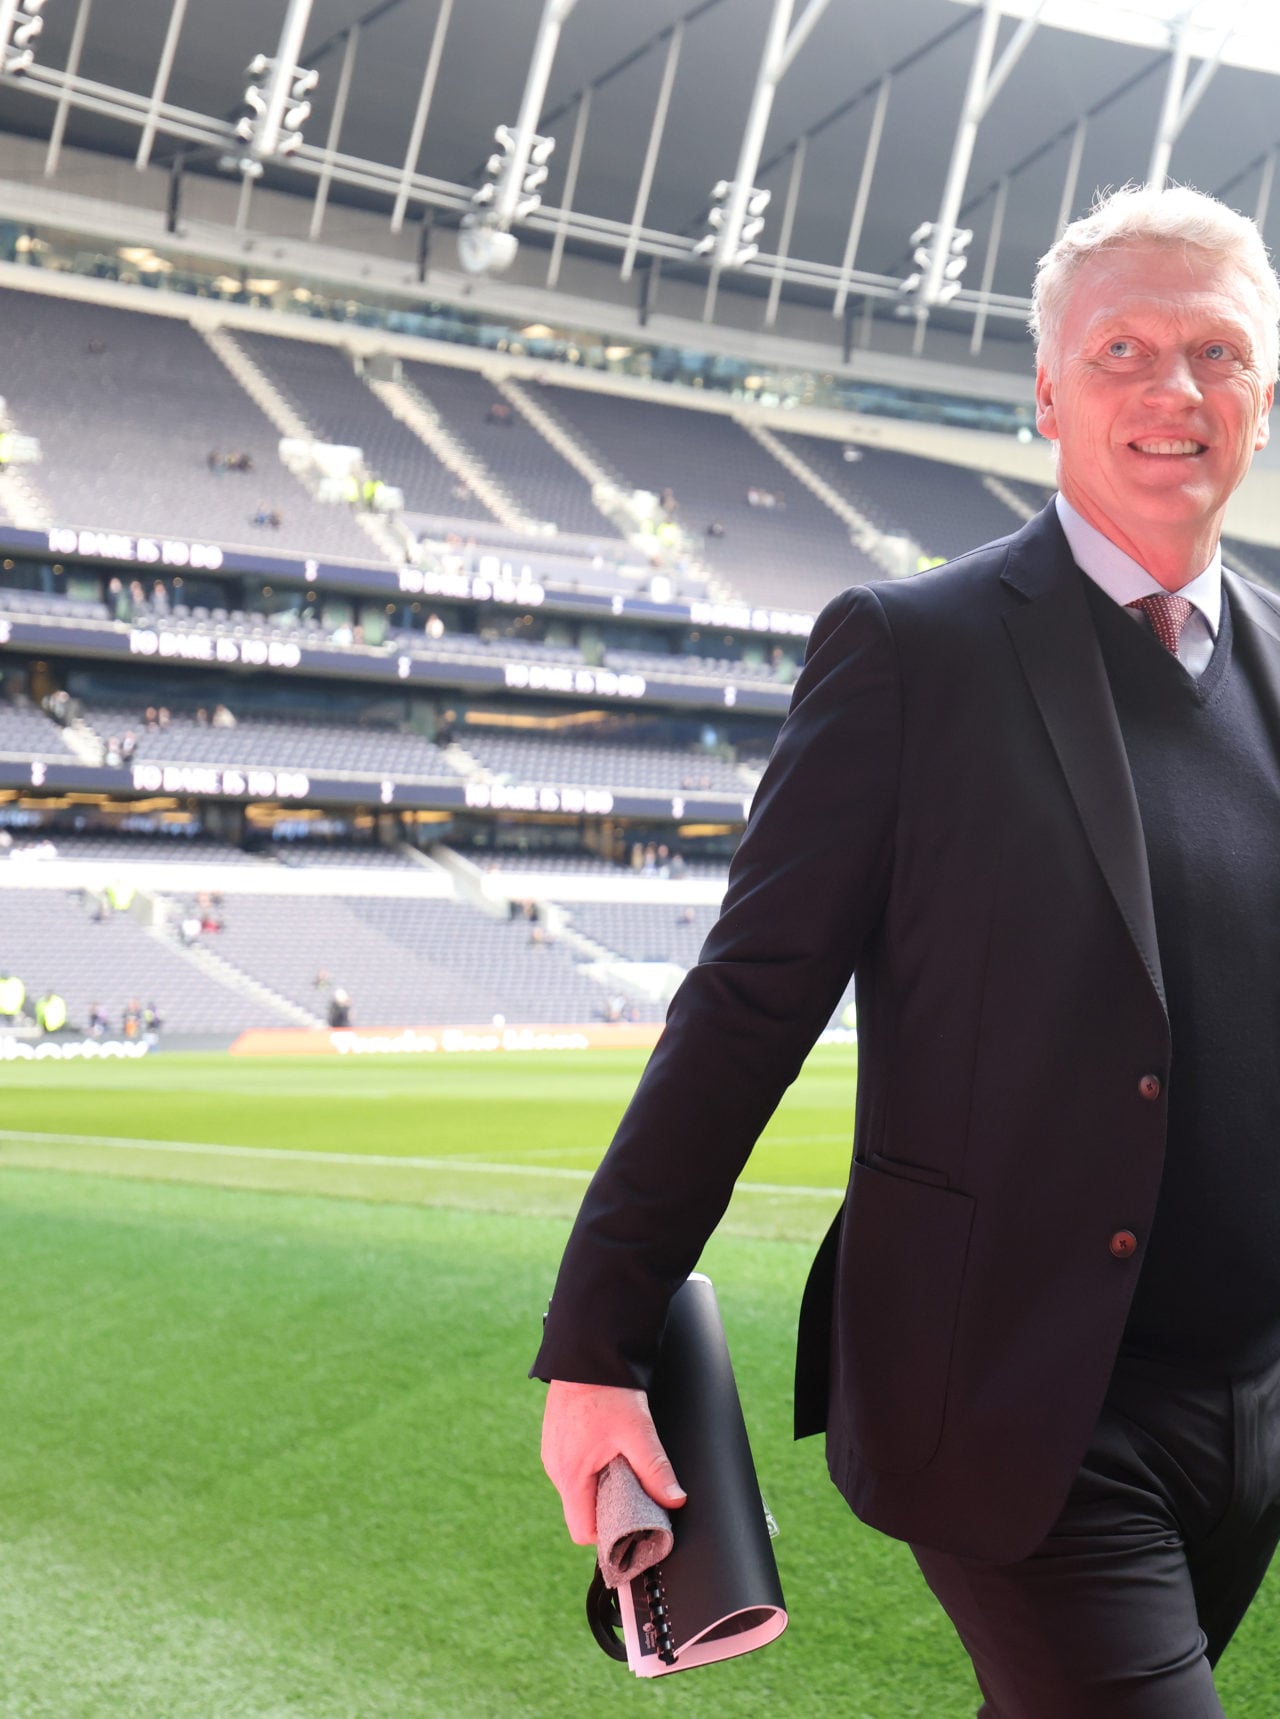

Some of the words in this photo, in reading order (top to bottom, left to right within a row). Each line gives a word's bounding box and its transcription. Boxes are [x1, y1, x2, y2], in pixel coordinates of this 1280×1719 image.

[49, 528, 77, 553] TO
[79, 531, 133, 559] DARE
[137, 538, 159, 563] IS
[162, 541, 189, 566] TO
[190, 544, 222, 570] DO
[130, 629, 158, 654] TO
[159, 632, 213, 659] DARE
[217, 638, 238, 661] IS
[241, 640, 267, 664] TO
[268, 642, 300, 667] DO
[133, 765, 162, 790] TO
[163, 767, 219, 793] DARE
[223, 770, 245, 794] IS
[248, 771, 275, 796] TO
[276, 772, 309, 797] DO
